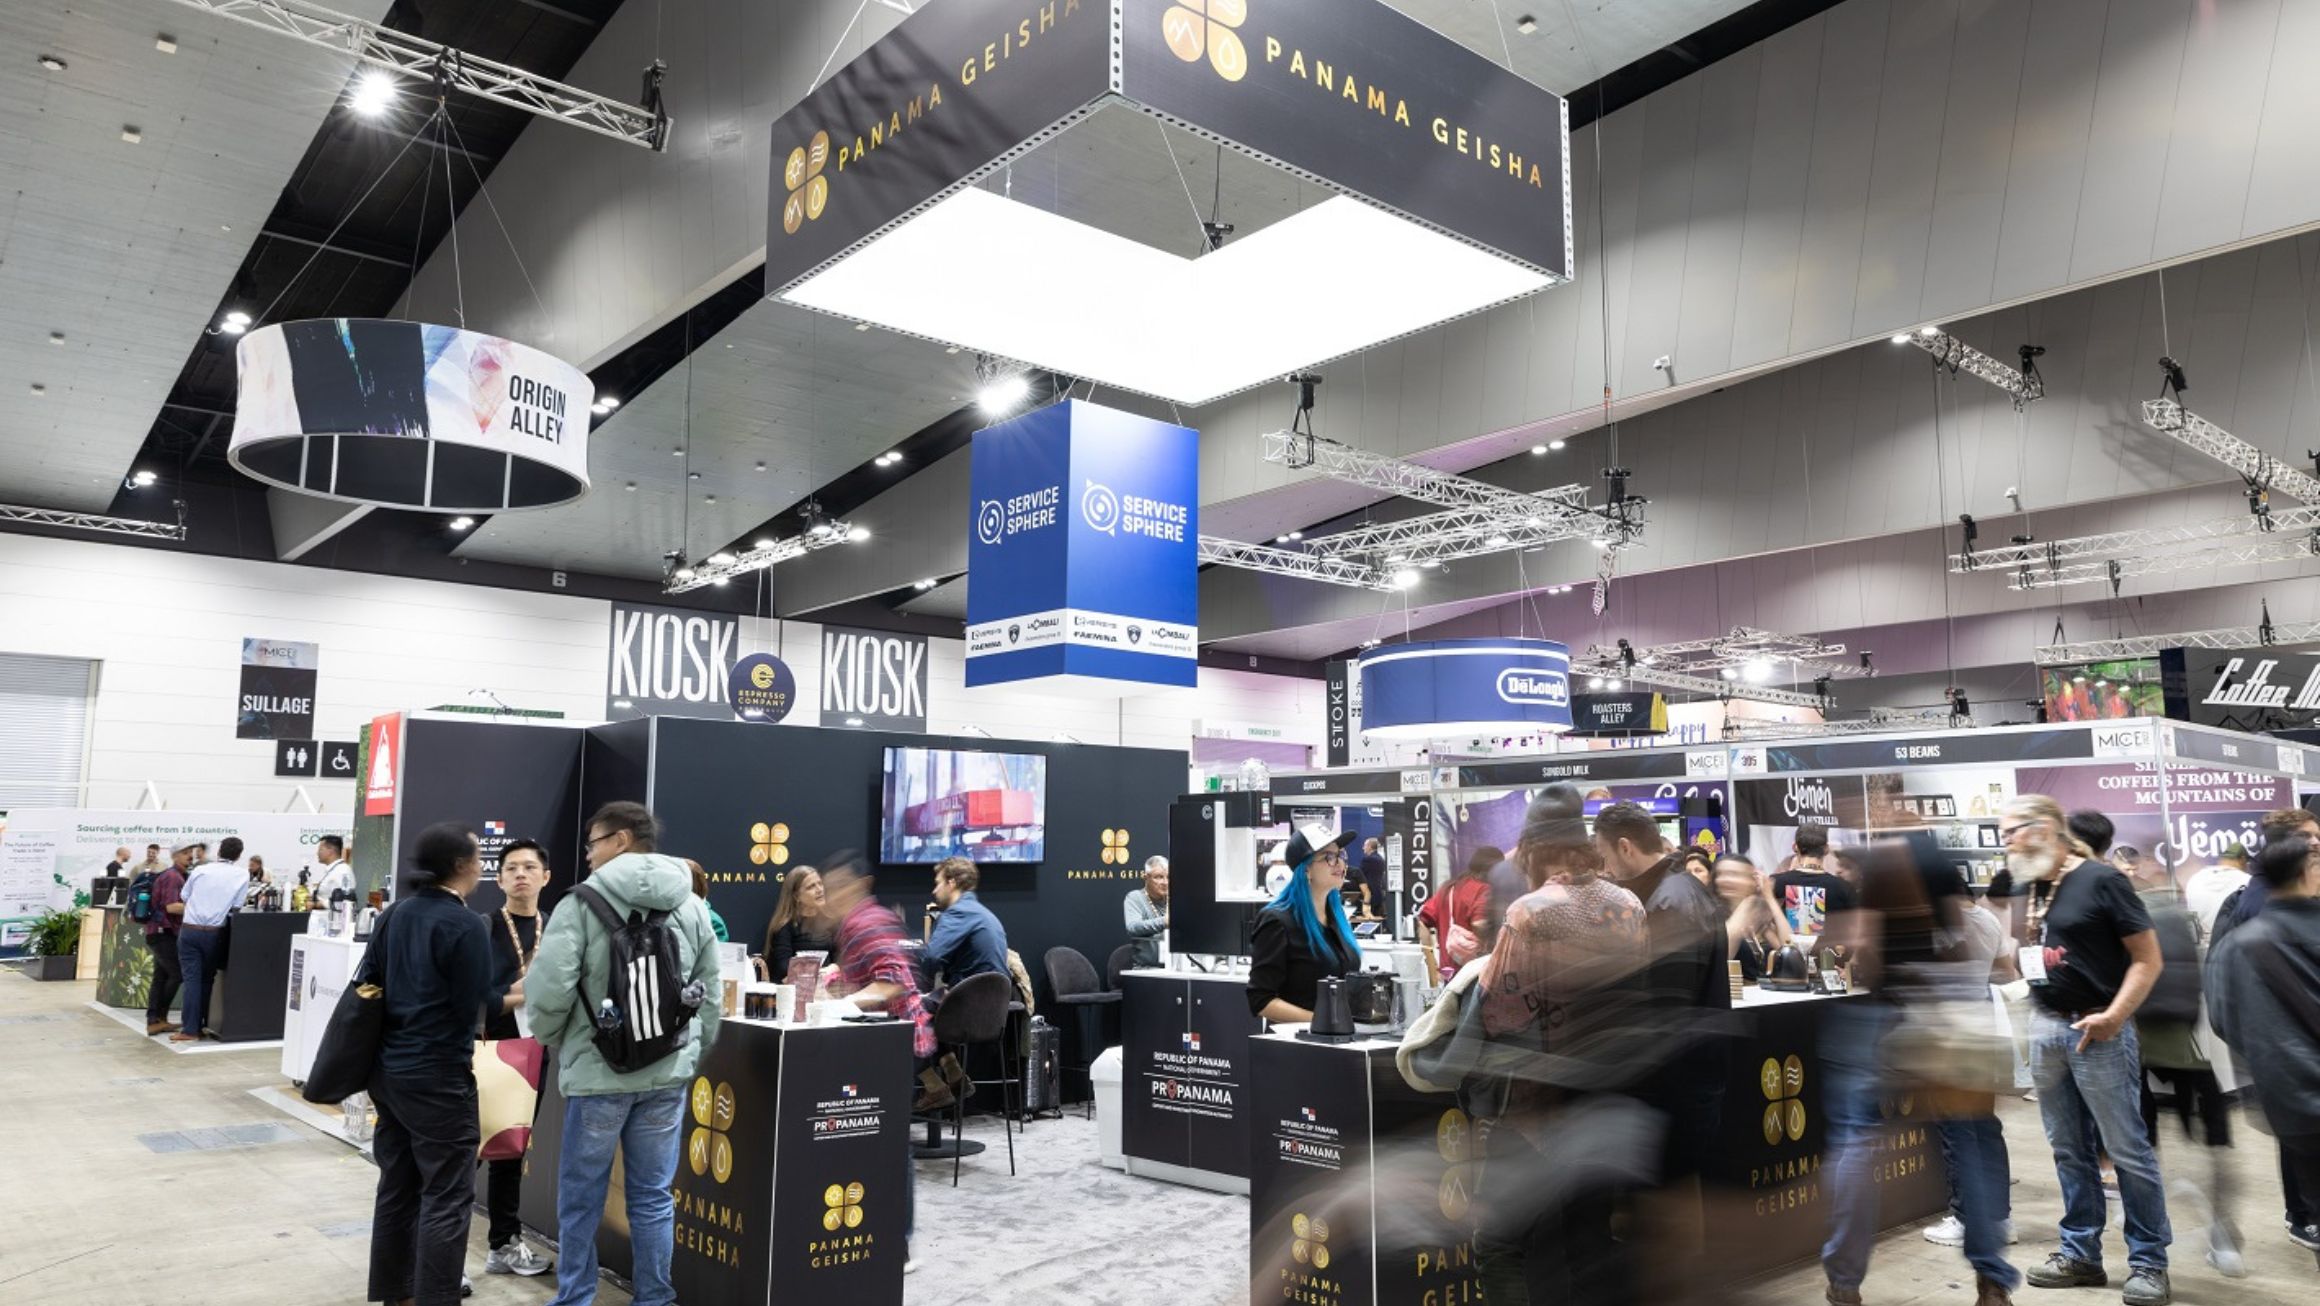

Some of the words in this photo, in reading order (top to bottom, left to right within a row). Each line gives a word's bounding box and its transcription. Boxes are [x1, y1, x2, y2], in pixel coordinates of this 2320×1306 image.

[1266, 35, 1411, 127] PANAMA
[1432, 117, 1543, 189] GEISHA
[838, 82, 943, 172] PANAMA
[509, 374, 566, 418] ORIGIN
[510, 405, 564, 445] ALLEY
[1007, 486, 1060, 516] SERVICE
[1122, 495, 1187, 524] SERVICE
[1007, 507, 1056, 535] SPHERE
[1122, 515, 1184, 543] SPHERE
[612, 609, 736, 704] KIOSK
[822, 631, 925, 718] KIOSK
[2201, 657, 2291, 708] Coffee
[242, 694, 311, 715] SULLAGE
[738, 690, 785, 700] ESPRESSO
[738, 697, 785, 707] COMPANY
[1593, 703, 1633, 714] ROASTERS
[1331, 680, 1344, 748] STOKE
[1601, 713, 1625, 724] ALLEY
[1895, 747, 1908, 759] 53
[1909, 745, 1940, 758] BEANS
[1573, 765, 1589, 776] MILK
[2098, 775, 2173, 789] COFFEES
[2177, 772, 2230, 787] FROM
[2233, 772, 2275, 785] THE
[2135, 789, 2246, 804] MOUNTAINS
[2250, 788, 2275, 801] OF
[77, 824, 120, 835] Sourcing
[123, 825, 153, 833] coffee
[156, 825, 179, 833] from
[1067, 870, 1114, 880] PANAMA
[1120, 870, 1146, 880] GEIS
[1153, 1051, 1186, 1064] REPUBLIC
[1187, 1055, 1198, 1064] OF
[1199, 1056, 1231, 1068] PANAMA
[1751, 1154, 1821, 1188] PANAMA
[1873, 1154, 1927, 1183] GEISHA
[673, 1189, 744, 1234] PANAMA
[1755, 1184, 1820, 1216] GEISHA
[676, 1223, 740, 1268] GEISHA
[809, 1234, 874, 1253] PANAMA
[811, 1249, 871, 1268] GEISHA
[1417, 1242, 1468, 1276] PAN
[1281, 1268, 1341, 1294] PANAMA
